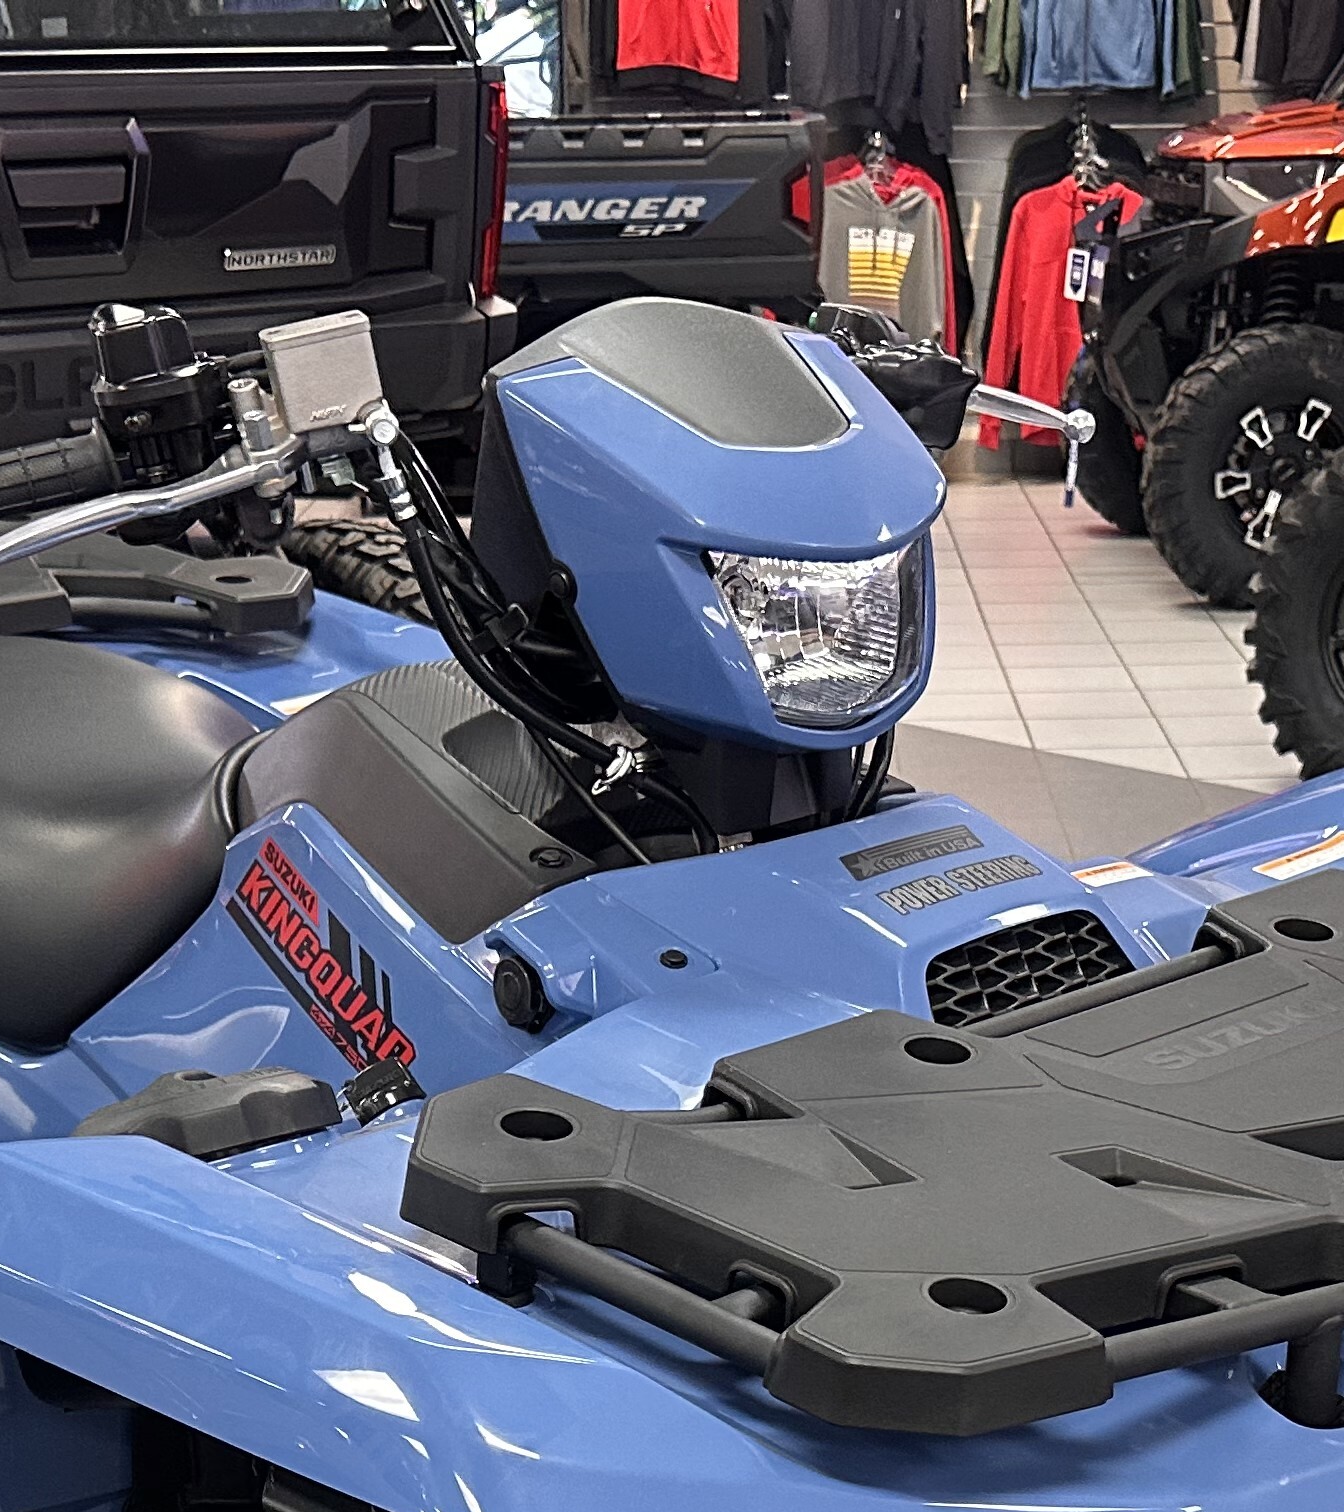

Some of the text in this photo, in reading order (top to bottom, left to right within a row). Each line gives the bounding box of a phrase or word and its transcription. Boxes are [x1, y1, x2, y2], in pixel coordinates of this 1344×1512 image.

[231, 250, 331, 267] NORTHSTAR
[263, 840, 317, 912] SUZUKI
[884, 837, 982, 869] Built in USA
[876, 875, 962, 915] POWER
[944, 855, 1043, 892] STEERING
[238, 861, 417, 1067] KINGQUAD
